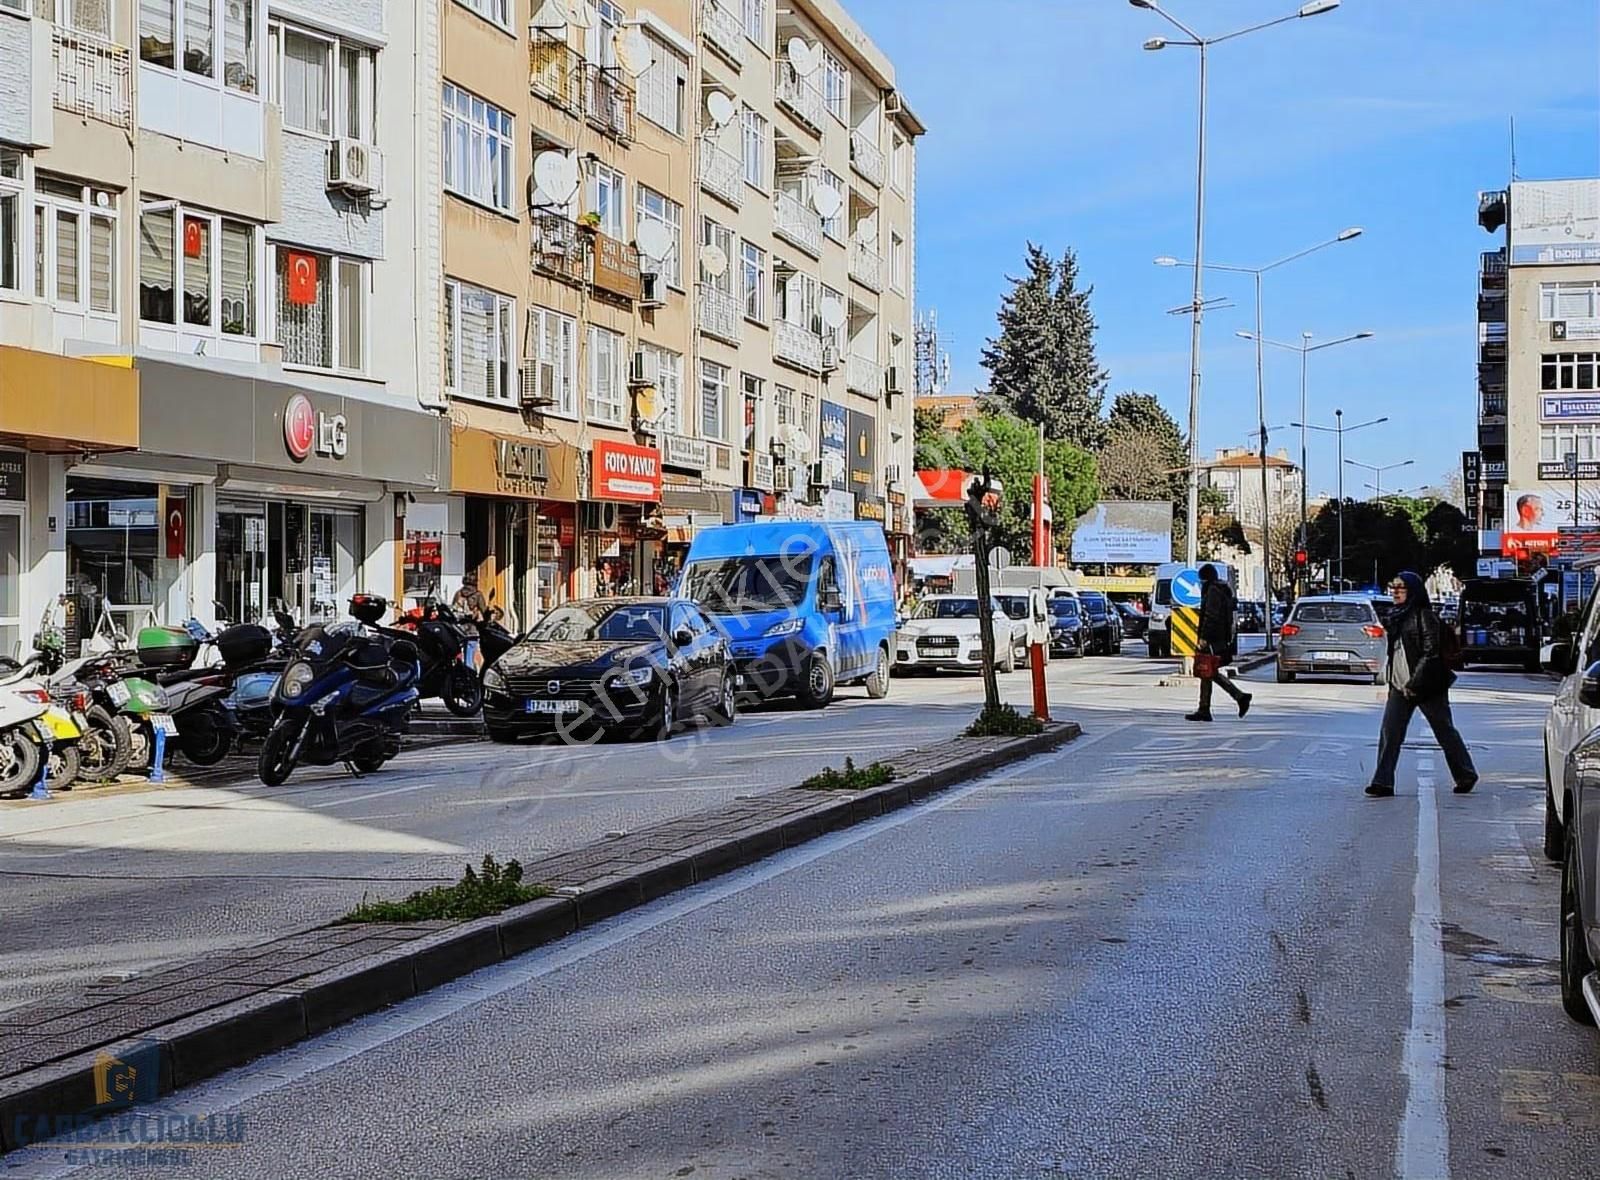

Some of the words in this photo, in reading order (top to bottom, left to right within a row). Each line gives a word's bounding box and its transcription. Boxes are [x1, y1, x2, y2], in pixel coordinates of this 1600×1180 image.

[319, 411, 347, 456] LG
[605, 451, 628, 474] FOTO
[628, 455, 657, 477] YAVUZ
[1466, 455, 1477, 520] HOTEL
[1556, 500, 1571, 510] 25
